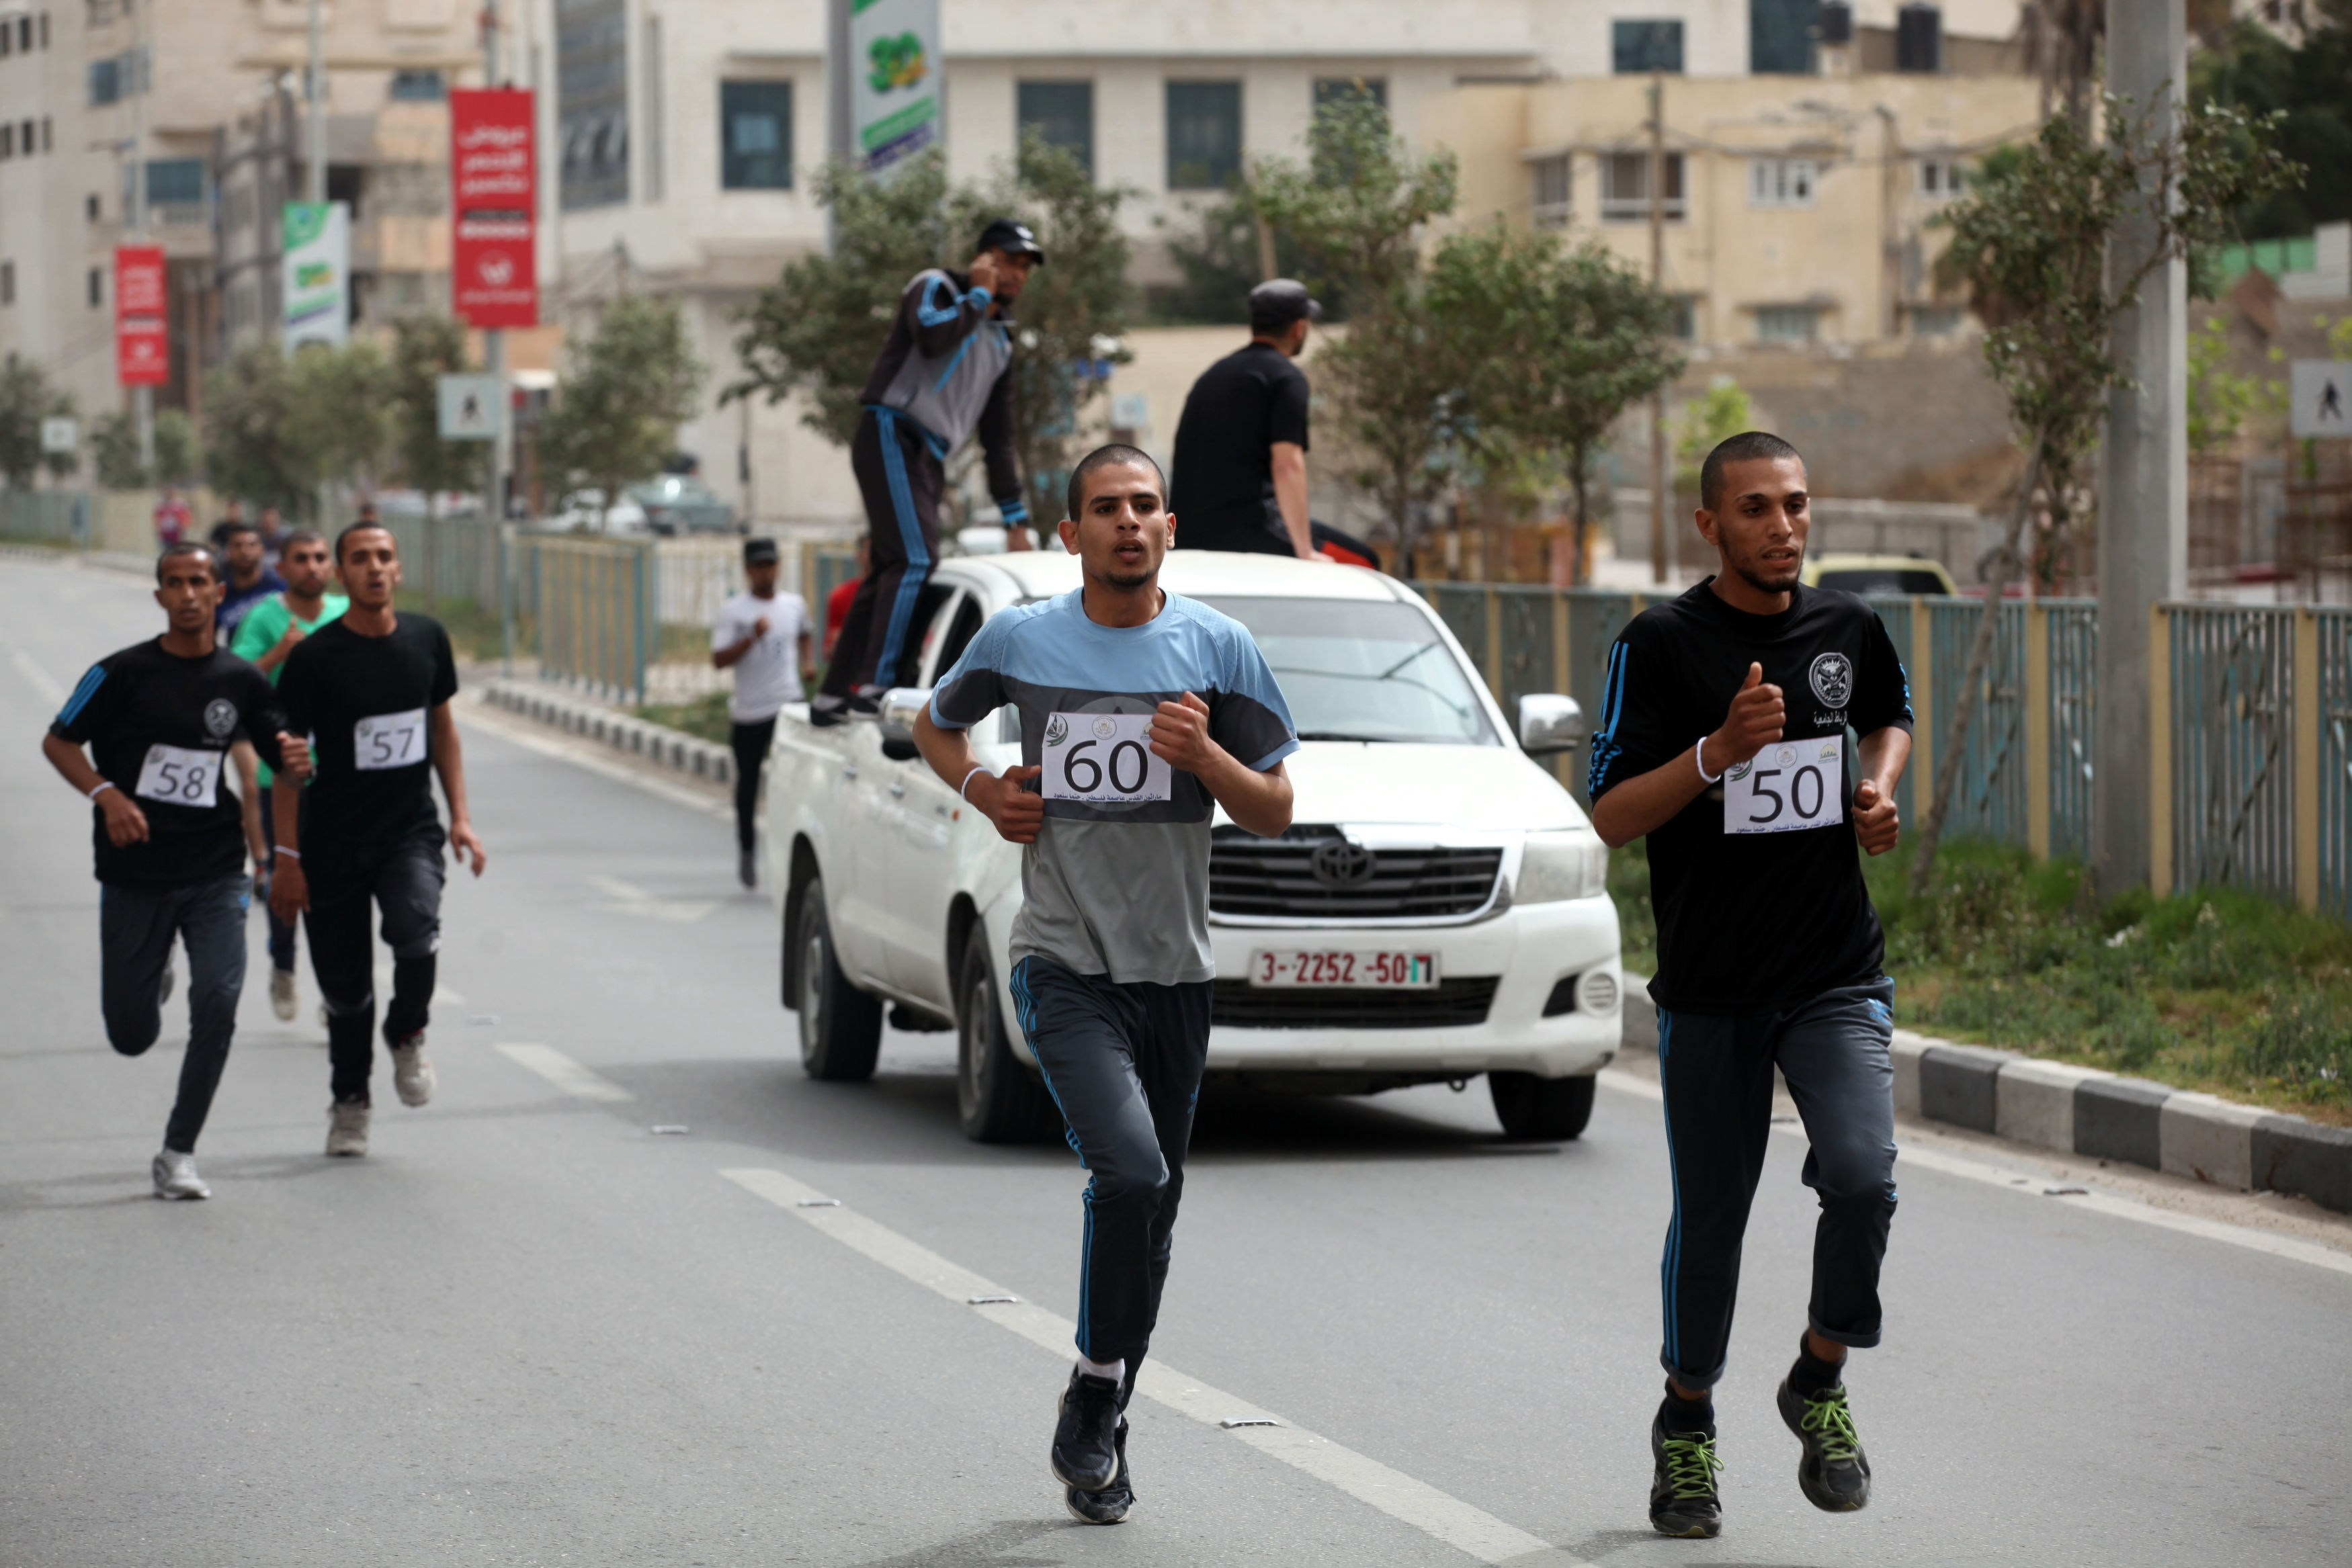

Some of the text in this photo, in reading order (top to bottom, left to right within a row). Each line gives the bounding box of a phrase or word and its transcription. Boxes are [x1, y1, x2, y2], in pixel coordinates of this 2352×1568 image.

[1814, 711, 1834, 728] الجامعية
[372, 728, 415, 763] 57
[153, 763, 206, 800] 58
[1064, 740, 1148, 793] 60
[1144, 793, 1162, 801] ماراثون
[1749, 765, 1824, 824] 50
